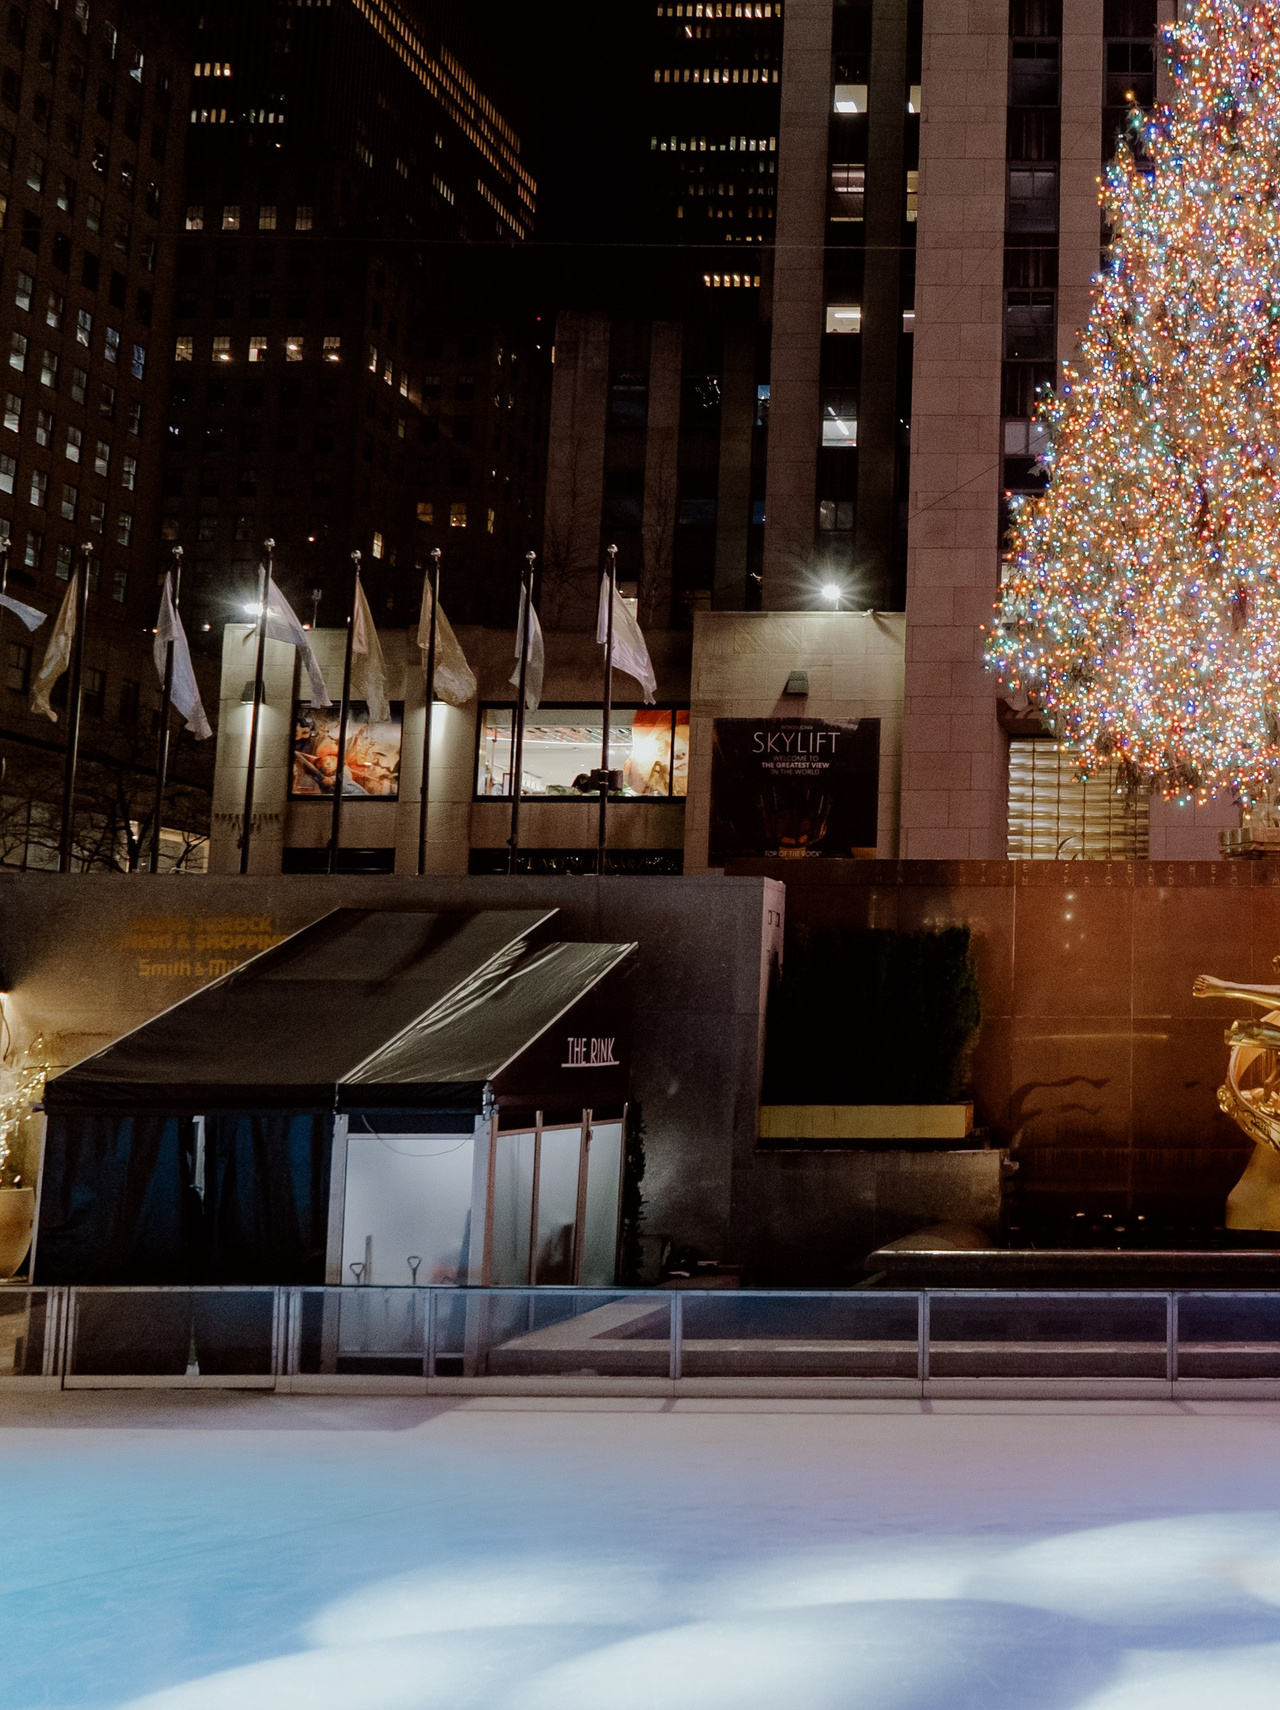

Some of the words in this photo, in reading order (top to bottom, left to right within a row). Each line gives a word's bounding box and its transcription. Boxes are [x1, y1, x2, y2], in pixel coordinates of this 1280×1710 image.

[752, 731, 841, 754] SKYLIFT
[1105, 863, 1238, 874] TEACHER
[138, 959, 191, 976] Smith
[567, 1037, 587, 1064] THE
[590, 1037, 615, 1063] RINK
